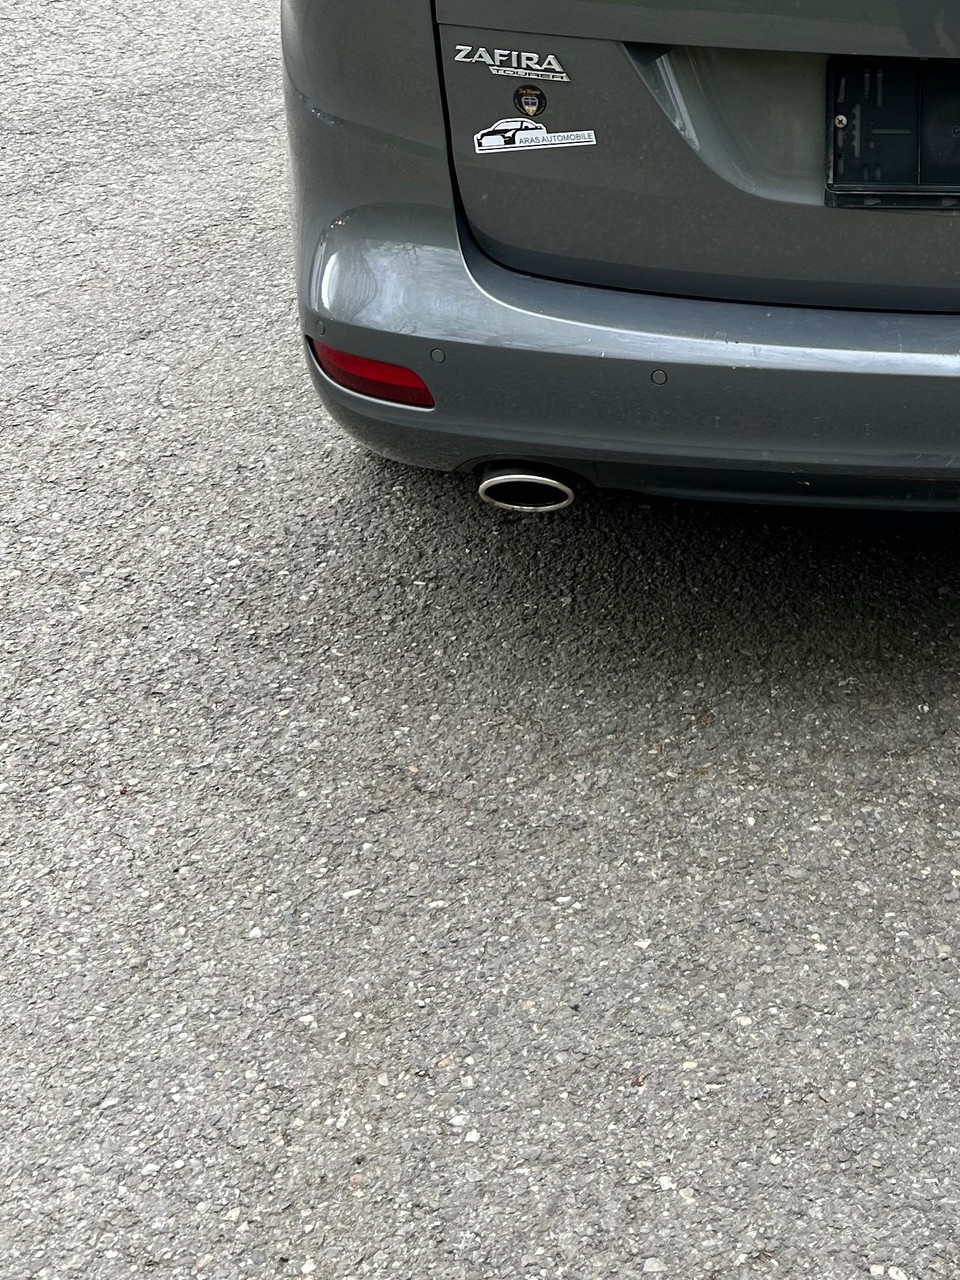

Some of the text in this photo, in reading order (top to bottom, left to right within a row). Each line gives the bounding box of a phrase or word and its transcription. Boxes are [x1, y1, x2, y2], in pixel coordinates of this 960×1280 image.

[454, 45, 565, 71] ZAFIRA
[494, 68, 565, 80] TOURER
[518, 133, 593, 145] ARAS AUTOMOBILE
